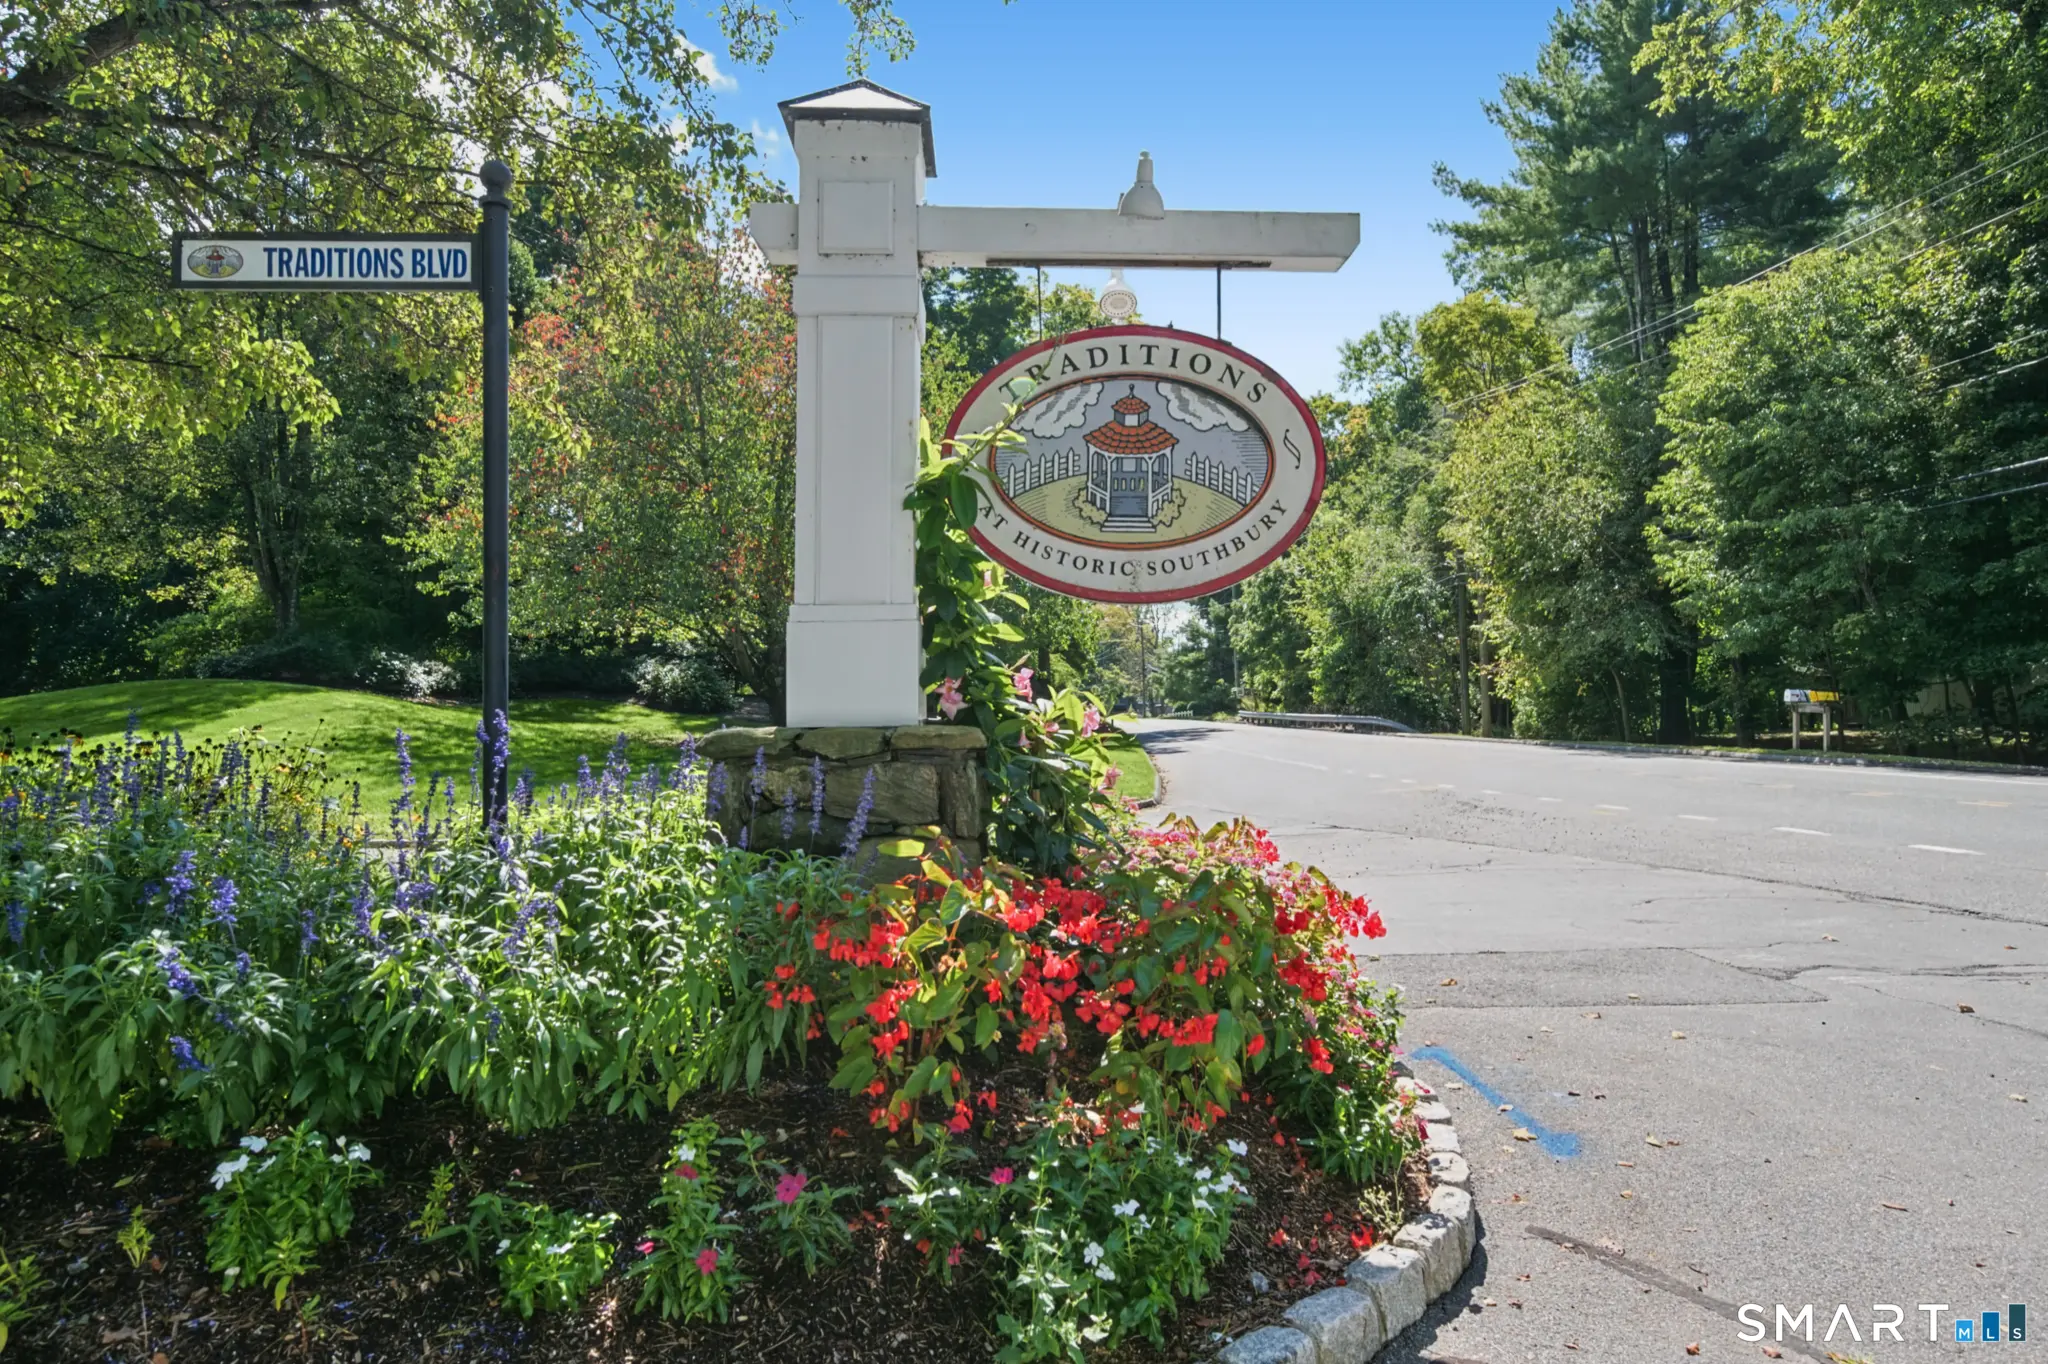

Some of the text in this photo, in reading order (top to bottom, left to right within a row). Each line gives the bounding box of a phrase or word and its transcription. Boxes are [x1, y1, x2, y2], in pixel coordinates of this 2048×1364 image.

[263, 246, 467, 279] TRADITIONS BLVD
[998, 343, 1268, 403] TRADITIONS
[979, 499, 1288, 577] AT HISTORIC SOUTHBURY
